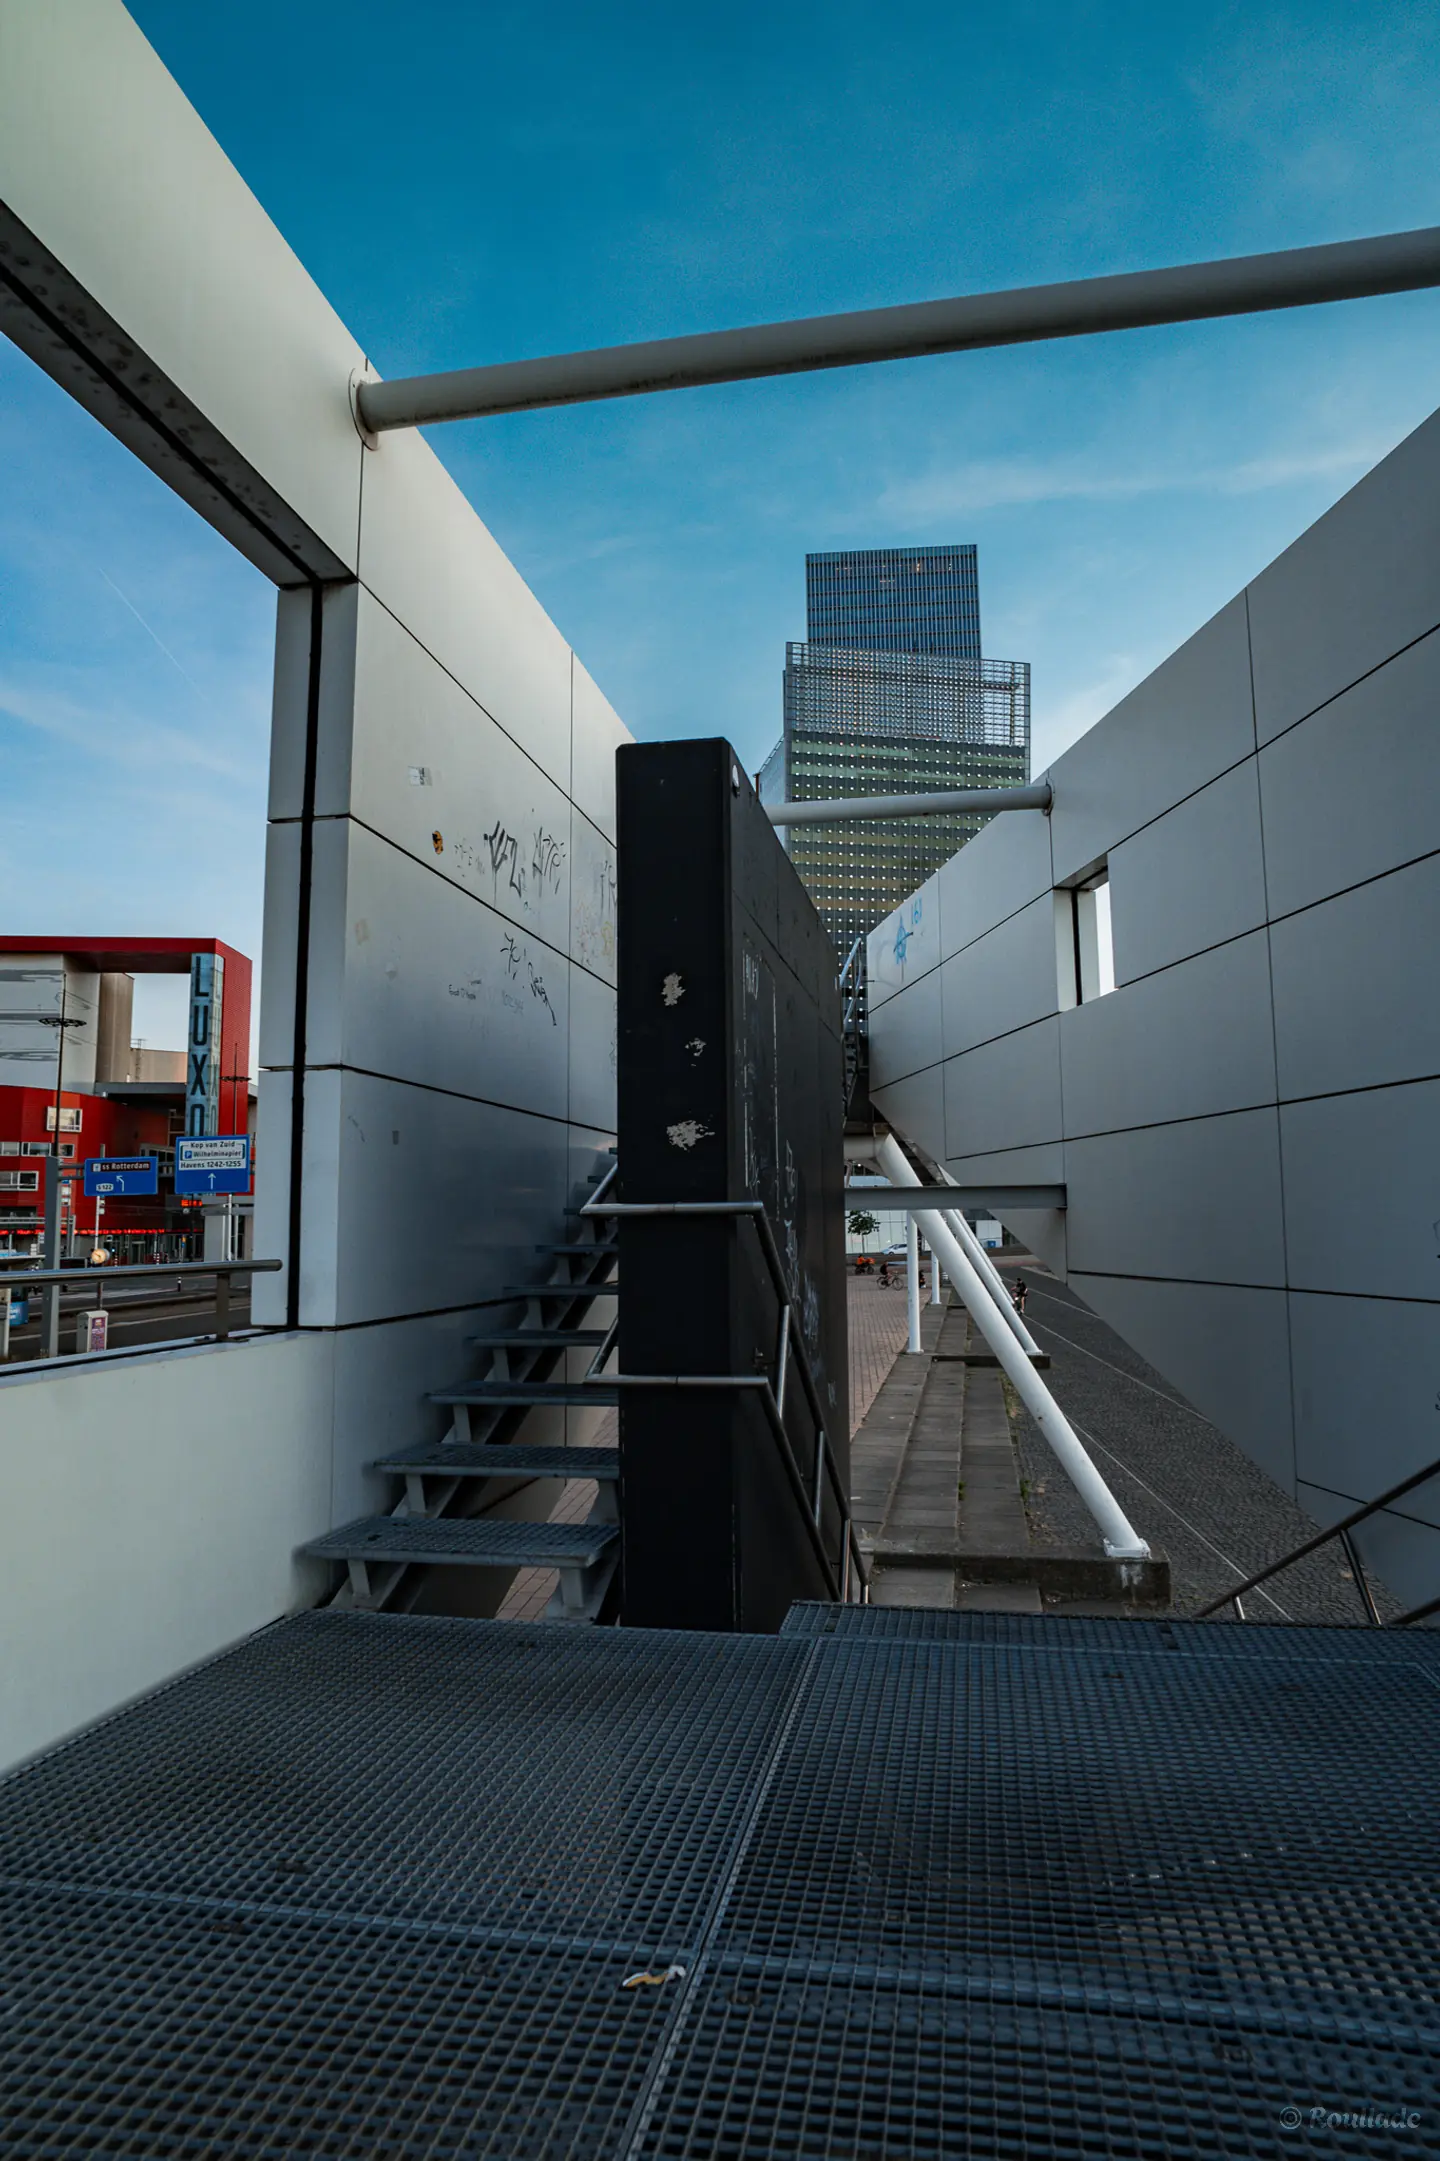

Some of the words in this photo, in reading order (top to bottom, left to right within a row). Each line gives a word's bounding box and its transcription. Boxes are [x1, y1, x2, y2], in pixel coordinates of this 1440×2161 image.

[190, 956, 209, 1136] LUXO
[193, 1150, 242, 1158] Wilhelminapier
[111, 1162, 150, 1170] Rotterdam
[207, 1160, 242, 1168] 1242-1255
